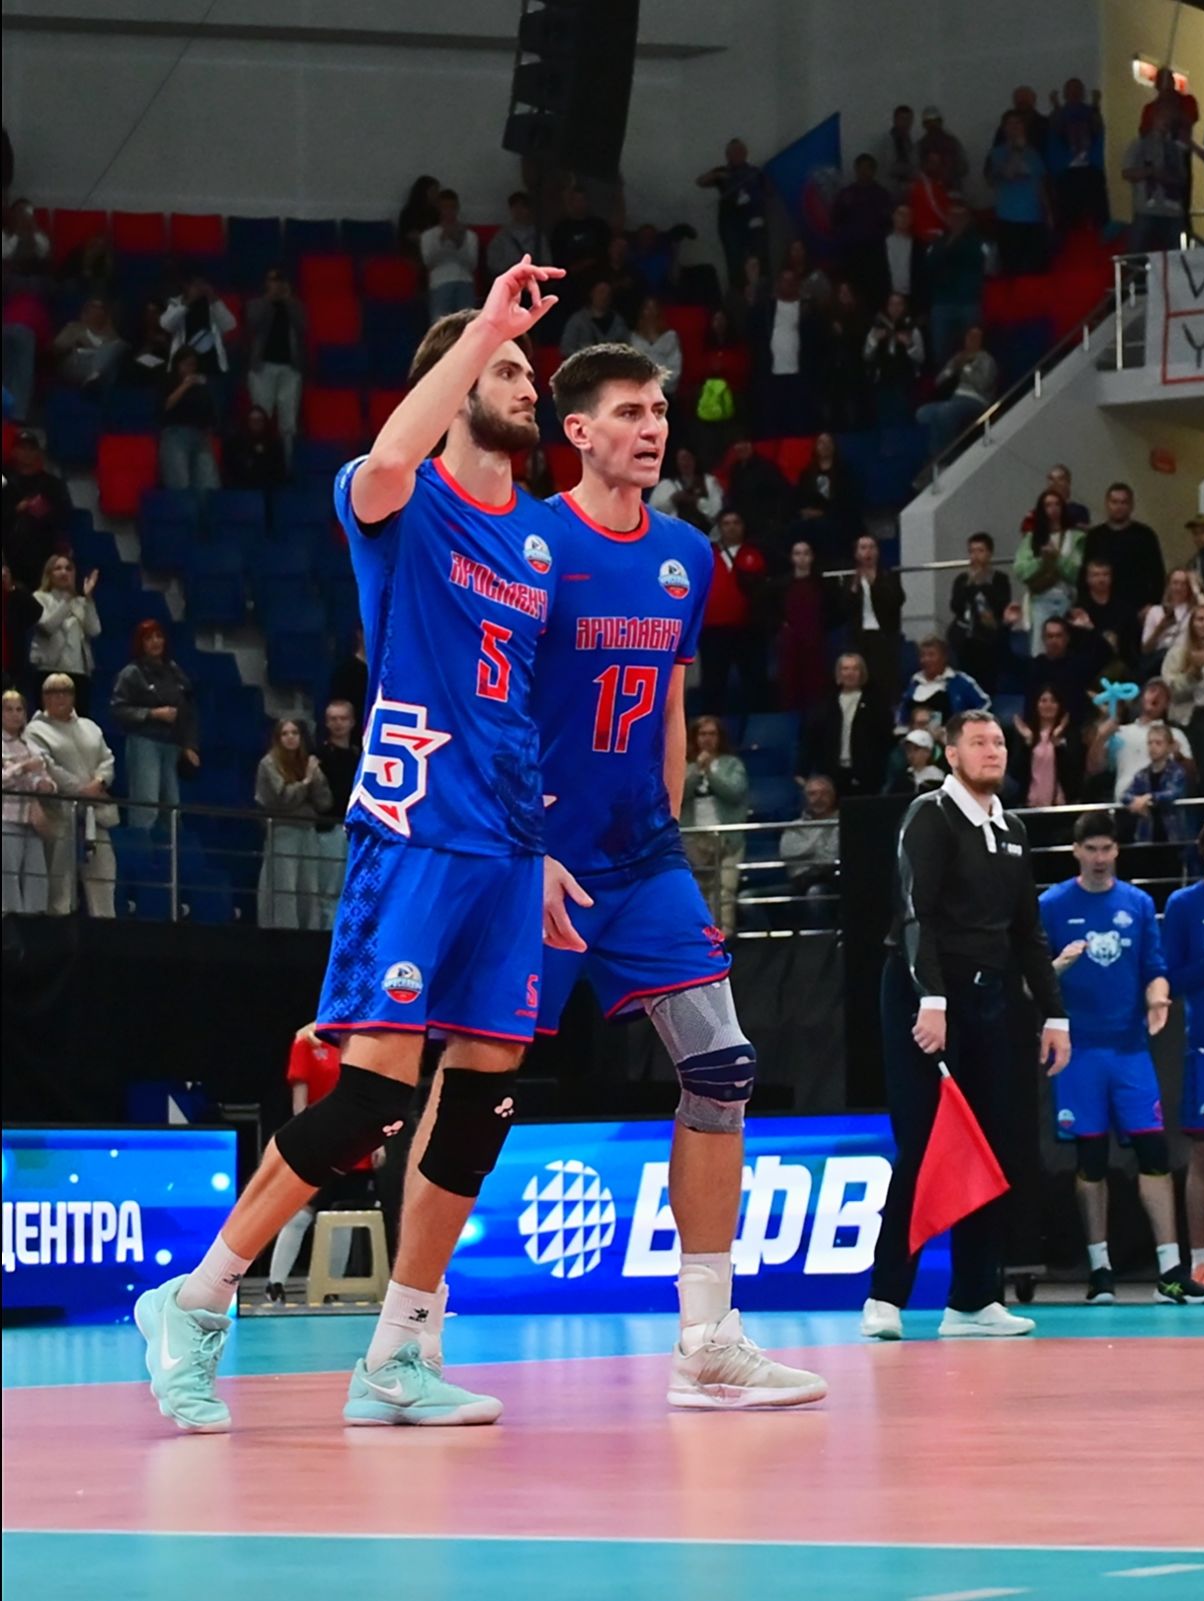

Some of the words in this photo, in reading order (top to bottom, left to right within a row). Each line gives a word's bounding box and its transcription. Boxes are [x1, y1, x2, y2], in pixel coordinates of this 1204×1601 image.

[476, 619, 513, 703] 5
[576, 616, 683, 652] ЯРОСЛАВИЧ
[593, 664, 659, 754] 17
